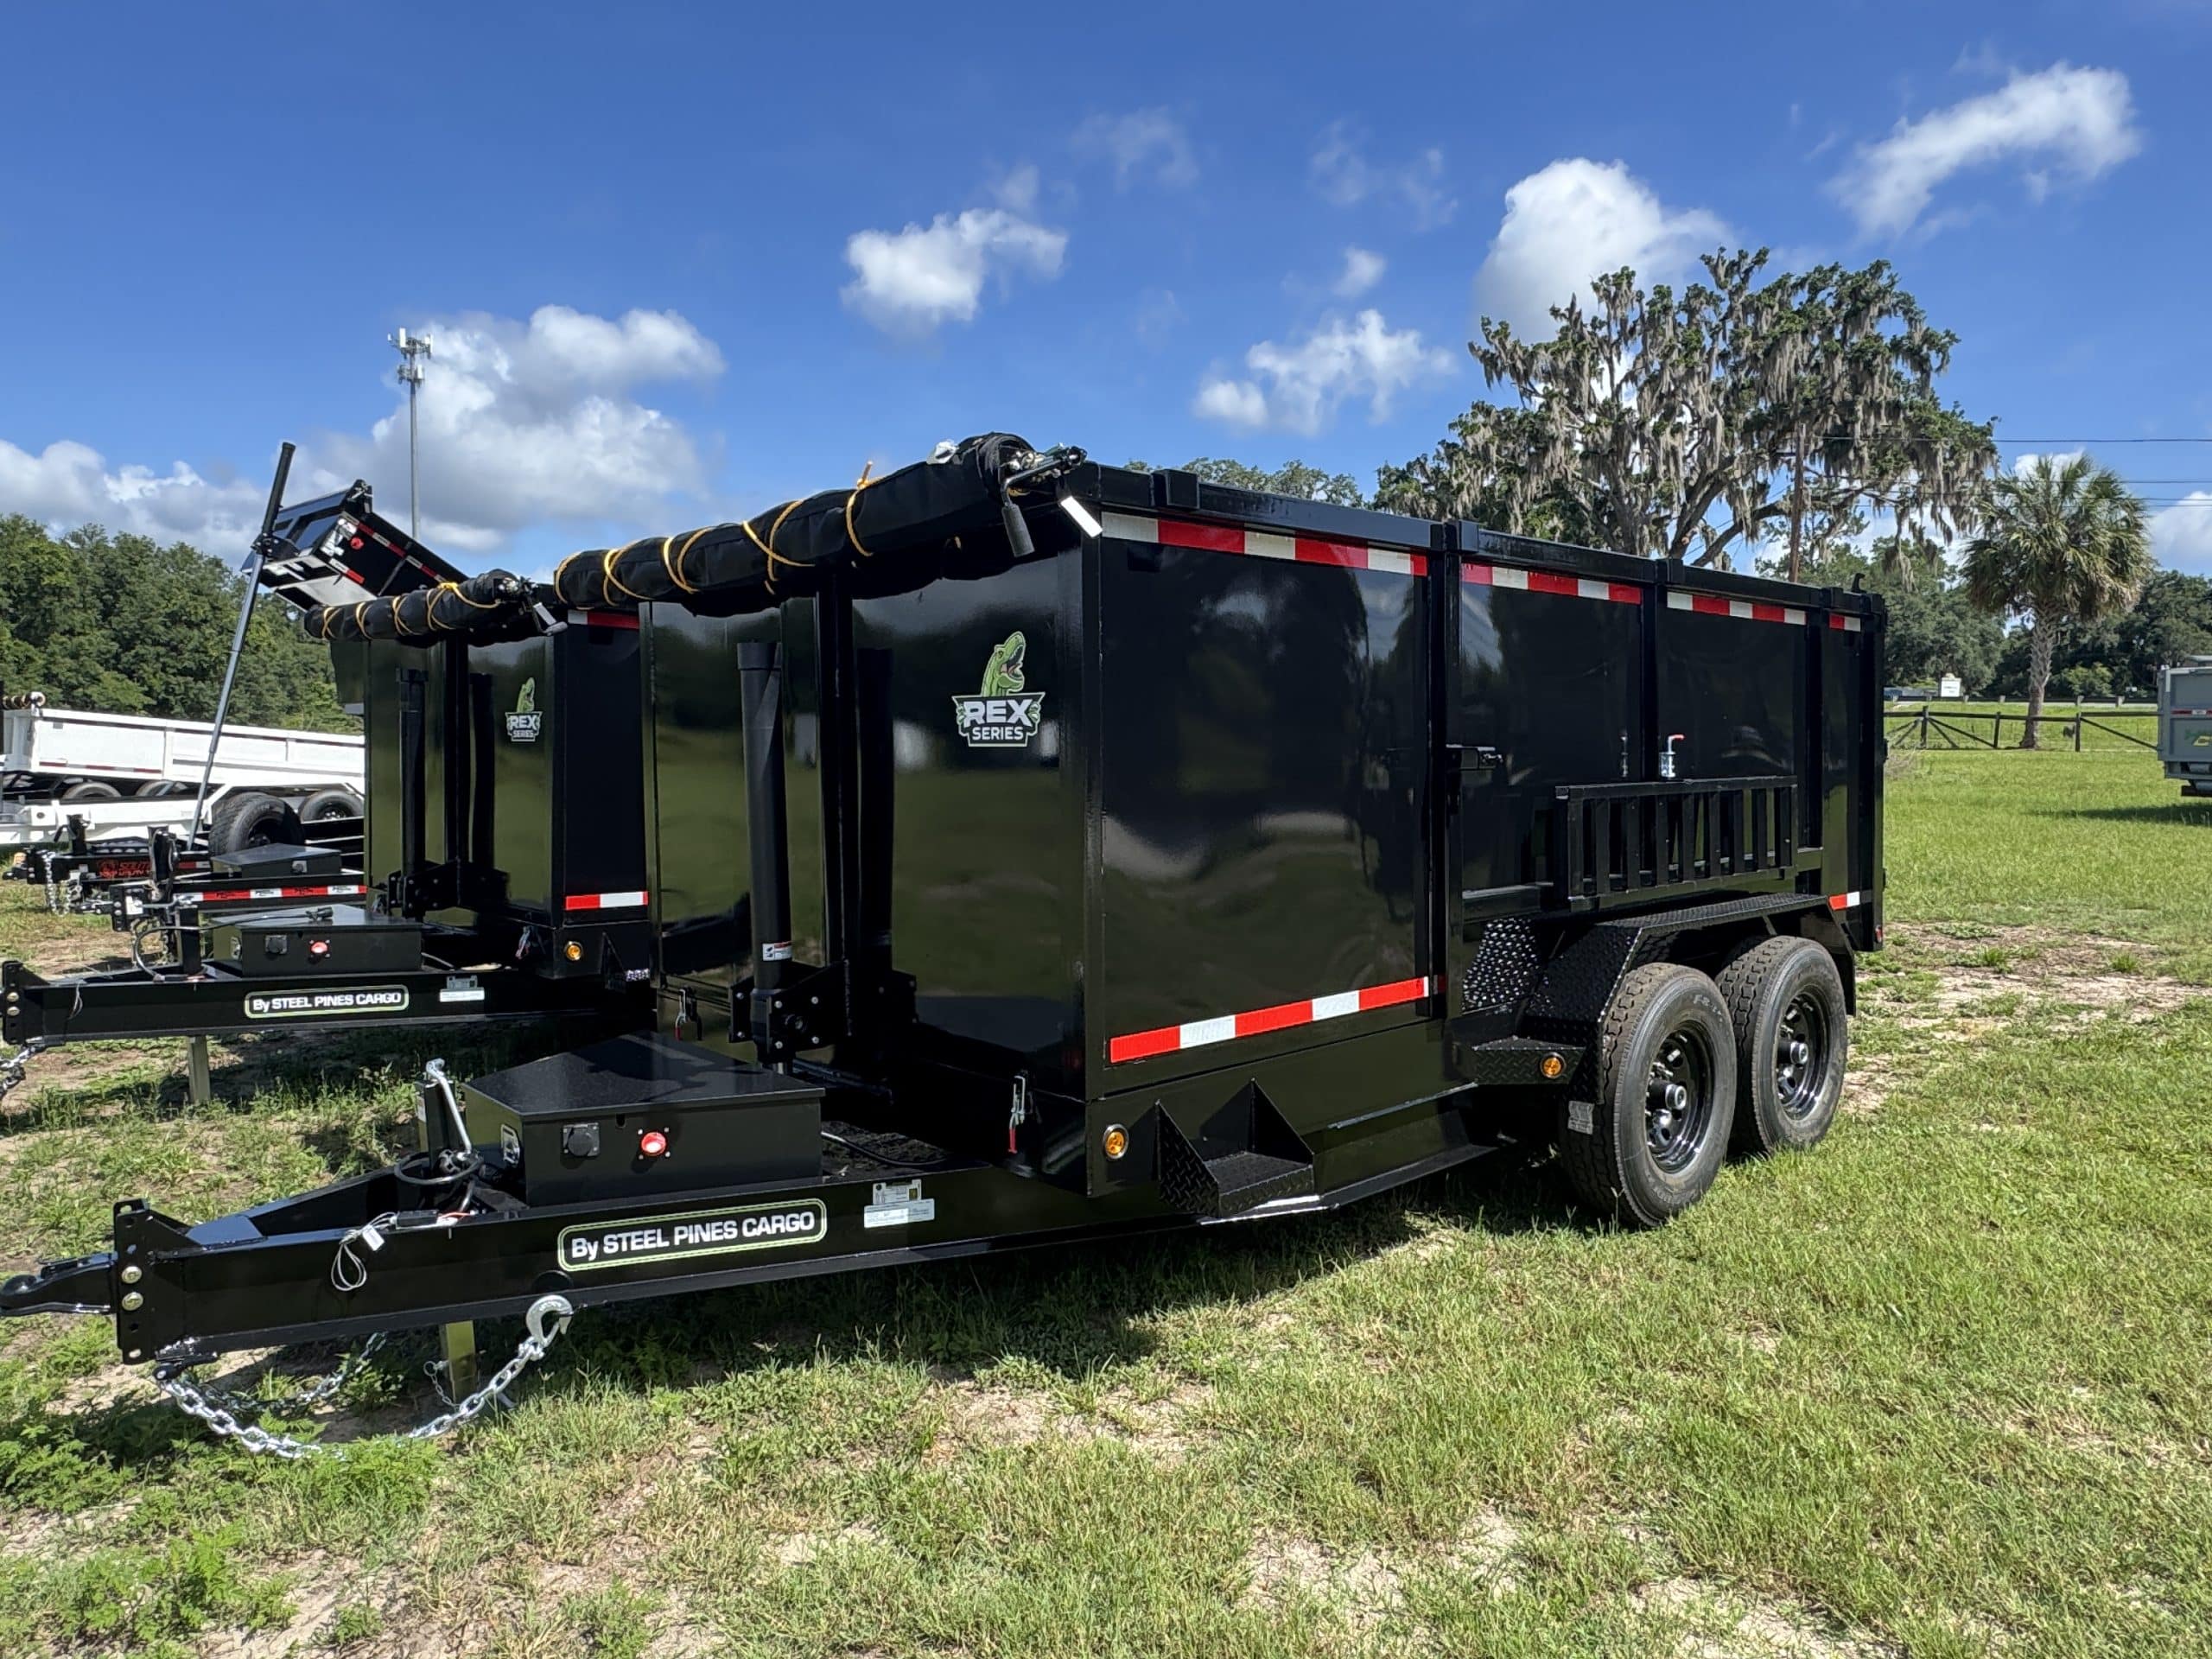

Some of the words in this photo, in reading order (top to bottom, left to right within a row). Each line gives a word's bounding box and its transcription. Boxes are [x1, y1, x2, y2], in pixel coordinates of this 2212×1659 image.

[510, 715, 537, 730] REX
[963, 699, 1033, 728] REX
[972, 727, 1023, 741] SERIES
[252, 999, 270, 1013] By
[271, 996, 312, 1010] STEEL
[314, 995, 353, 1007] PINES
[355, 992, 402, 1005] CARGO
[571, 1238, 598, 1261] By
[603, 1230, 669, 1255] STEEL
[674, 1220, 736, 1245] PINES
[741, 1211, 814, 1237] CARGO
